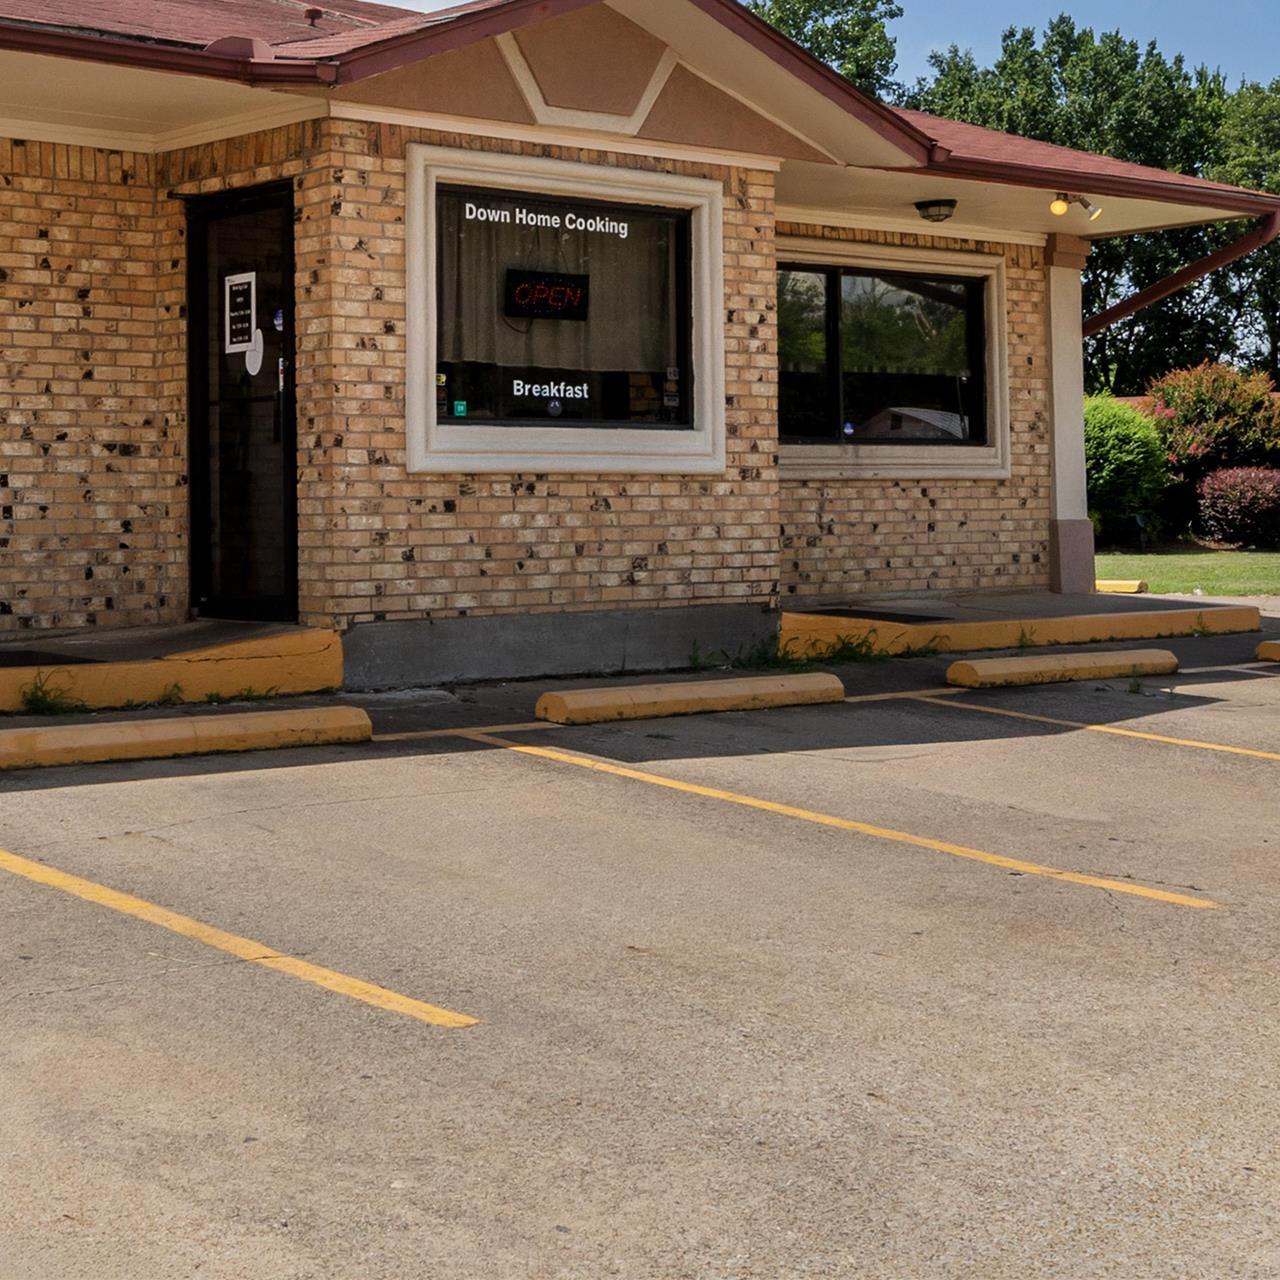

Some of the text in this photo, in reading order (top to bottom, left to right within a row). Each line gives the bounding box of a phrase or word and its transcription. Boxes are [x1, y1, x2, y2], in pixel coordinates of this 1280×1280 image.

[465, 203, 629, 238] Down Home Cooking
[514, 283, 582, 307] OPEN
[513, 379, 590, 400] Breakfast
